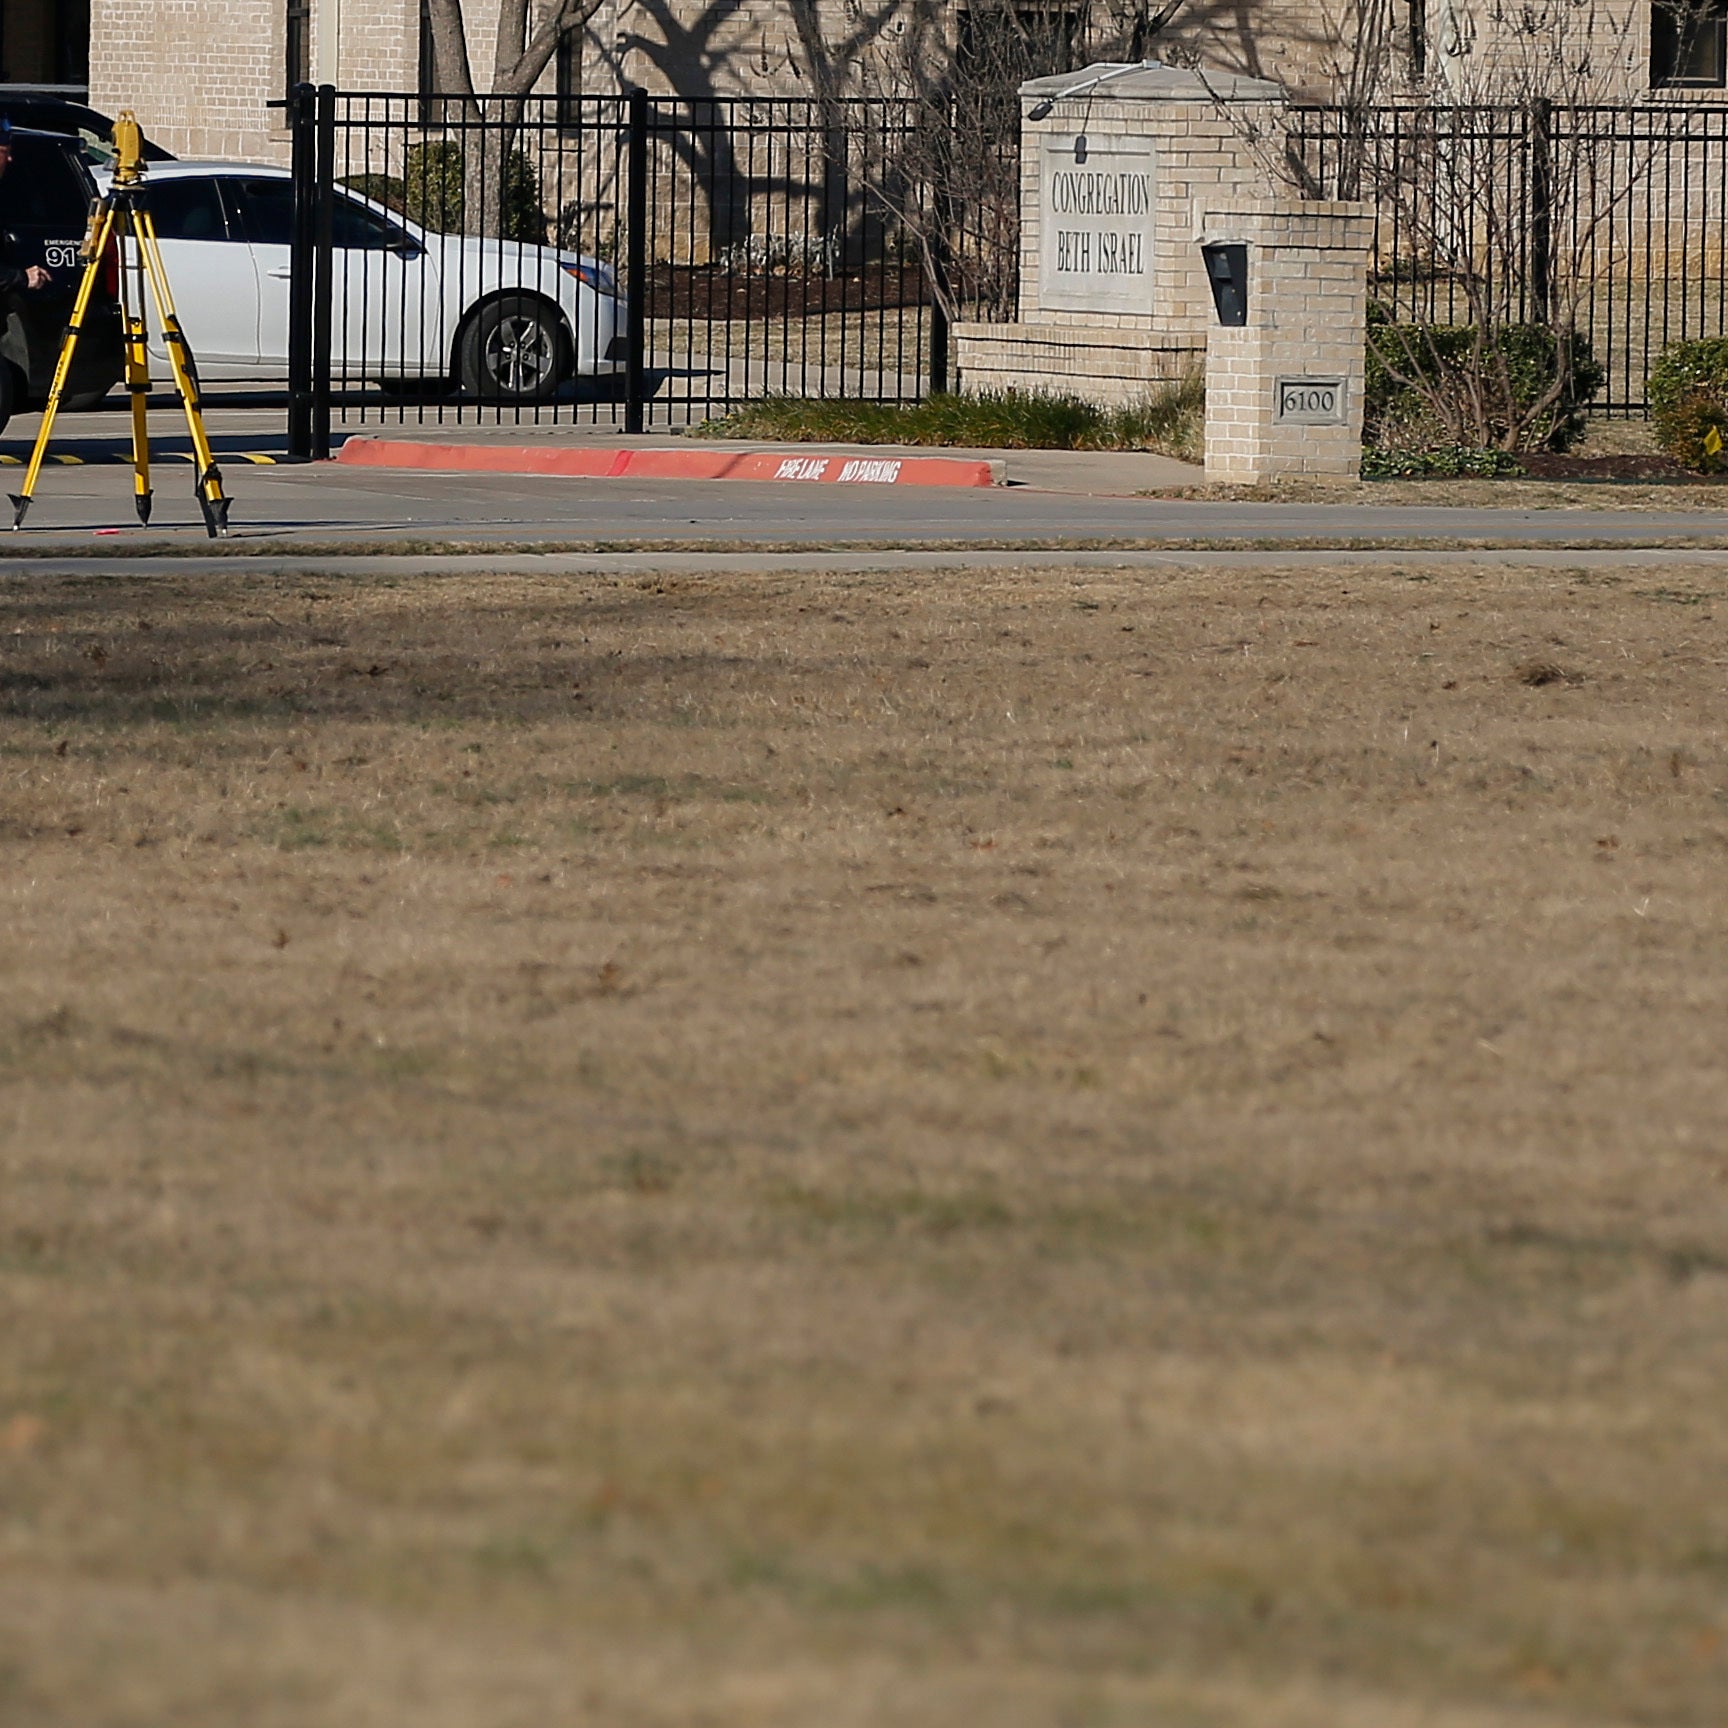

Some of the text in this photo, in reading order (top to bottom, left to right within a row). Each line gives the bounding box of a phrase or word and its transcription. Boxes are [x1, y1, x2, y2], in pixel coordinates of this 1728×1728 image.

[1052, 171, 1150, 215] CONGREGATION
[1057, 230, 1144, 274] BETH ISRAEL
[1285, 391, 1334, 411] 6100
[773, 458, 902, 483] FIRE LANE NO PARKING
